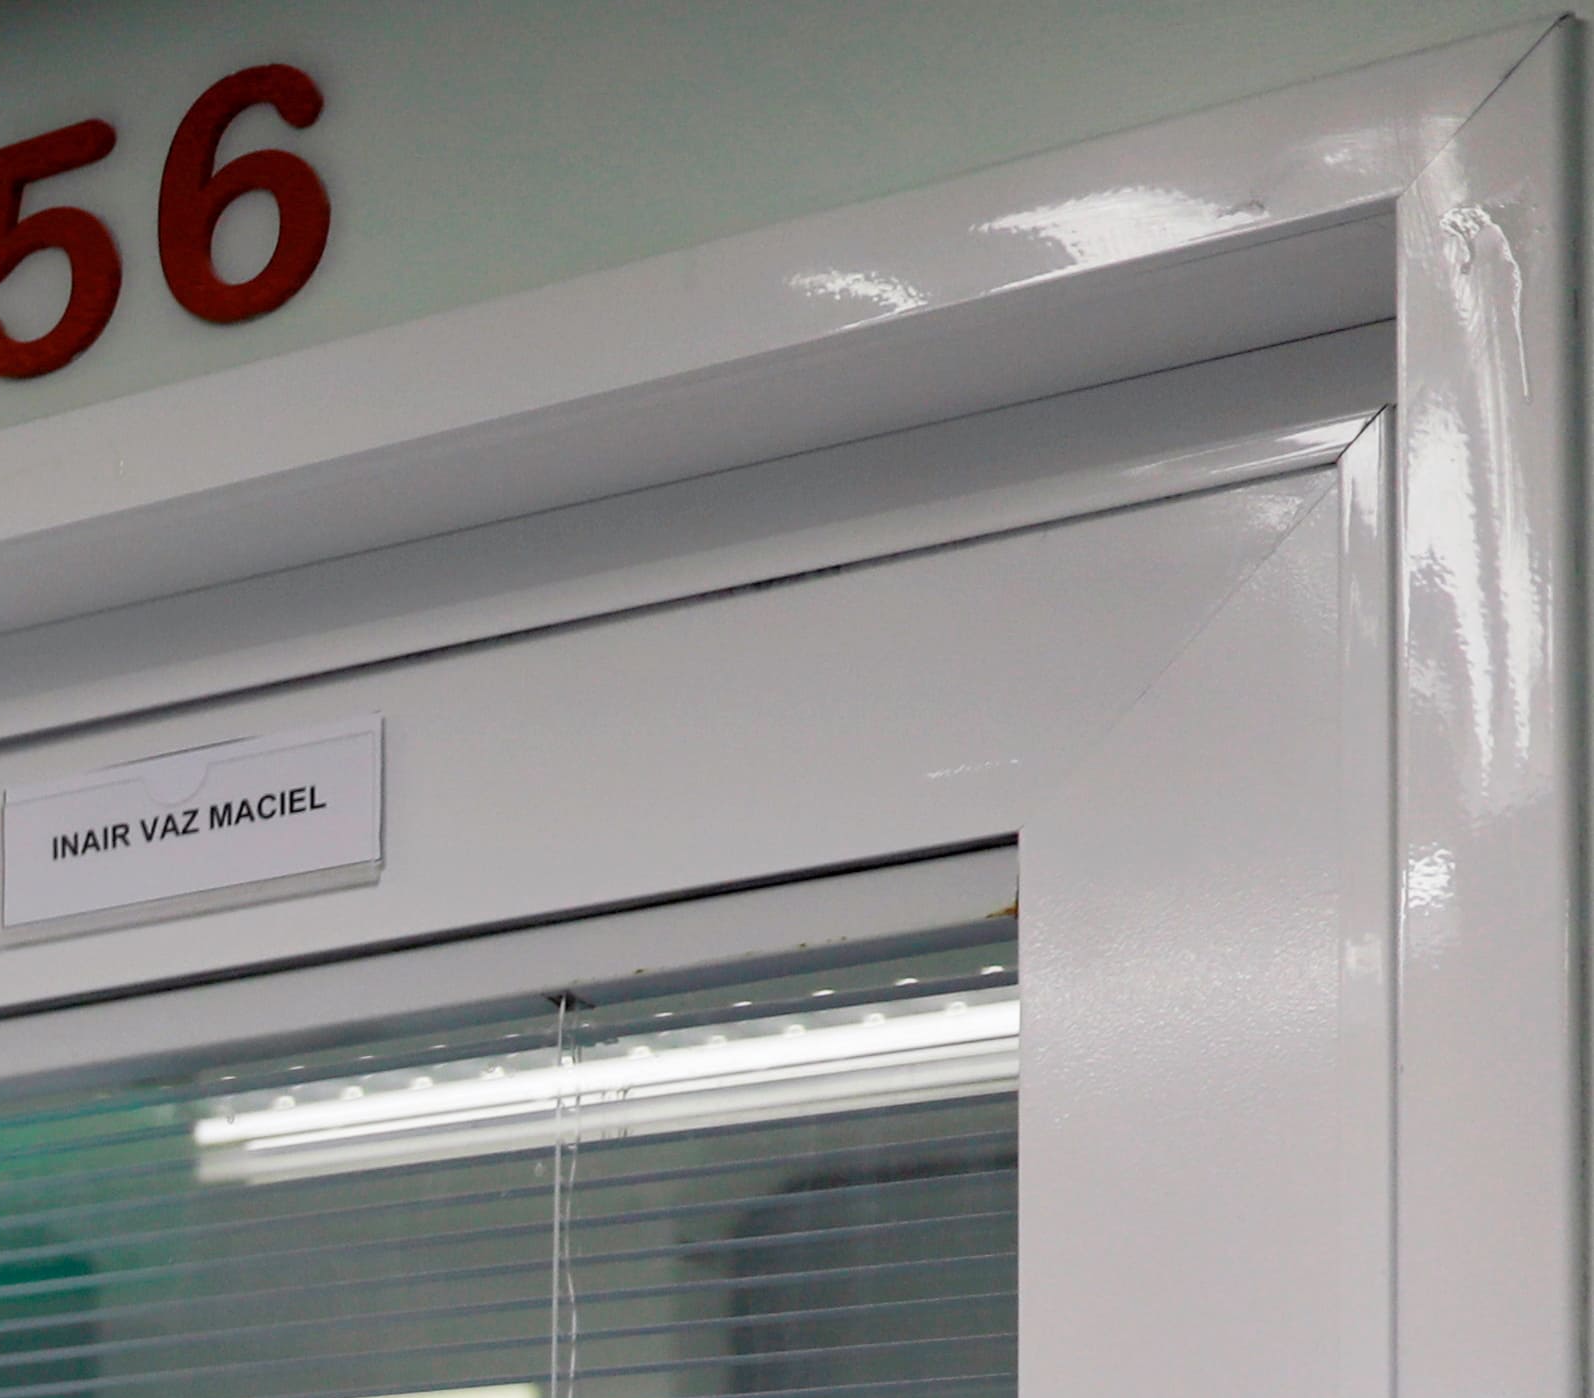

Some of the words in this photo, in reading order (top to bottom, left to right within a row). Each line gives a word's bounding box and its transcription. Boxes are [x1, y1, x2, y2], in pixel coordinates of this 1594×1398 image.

[52, 823, 131, 861] INAIR
[140, 809, 200, 842] VAZ
[208, 785, 327, 830] MACIEL
